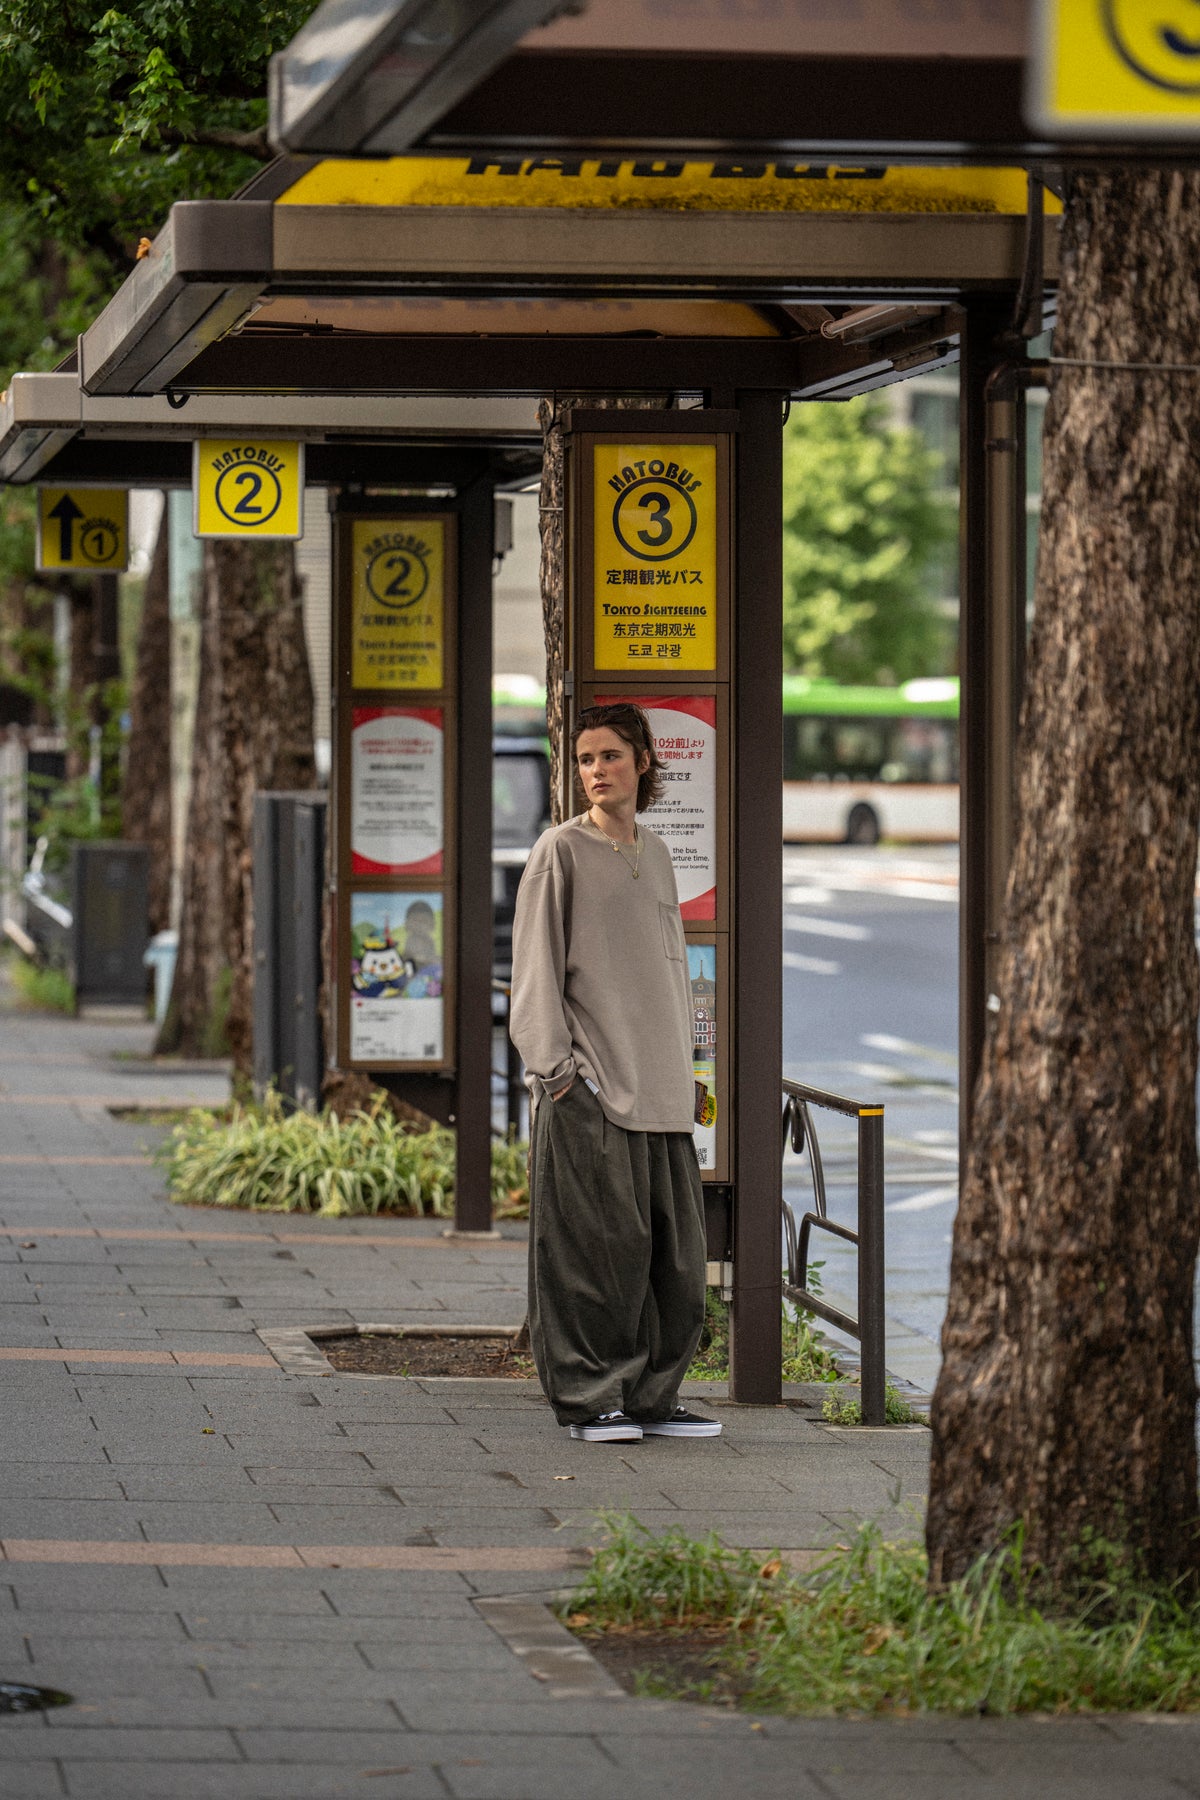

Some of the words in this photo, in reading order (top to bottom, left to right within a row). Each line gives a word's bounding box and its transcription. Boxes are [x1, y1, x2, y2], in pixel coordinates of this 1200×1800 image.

[211, 446, 286, 472] HATOBUS
[607, 459, 702, 493] HATOBUS
[234, 471, 262, 514] 2
[637, 491, 673, 547] 3
[92, 532, 104, 556] 1
[384, 556, 411, 597] 2
[606, 569, 703, 585] 定期観光バス
[613, 622, 696, 637] 东京定期观光
[627, 644, 653, 656] 도쿄
[656, 643, 682, 658] 관광
